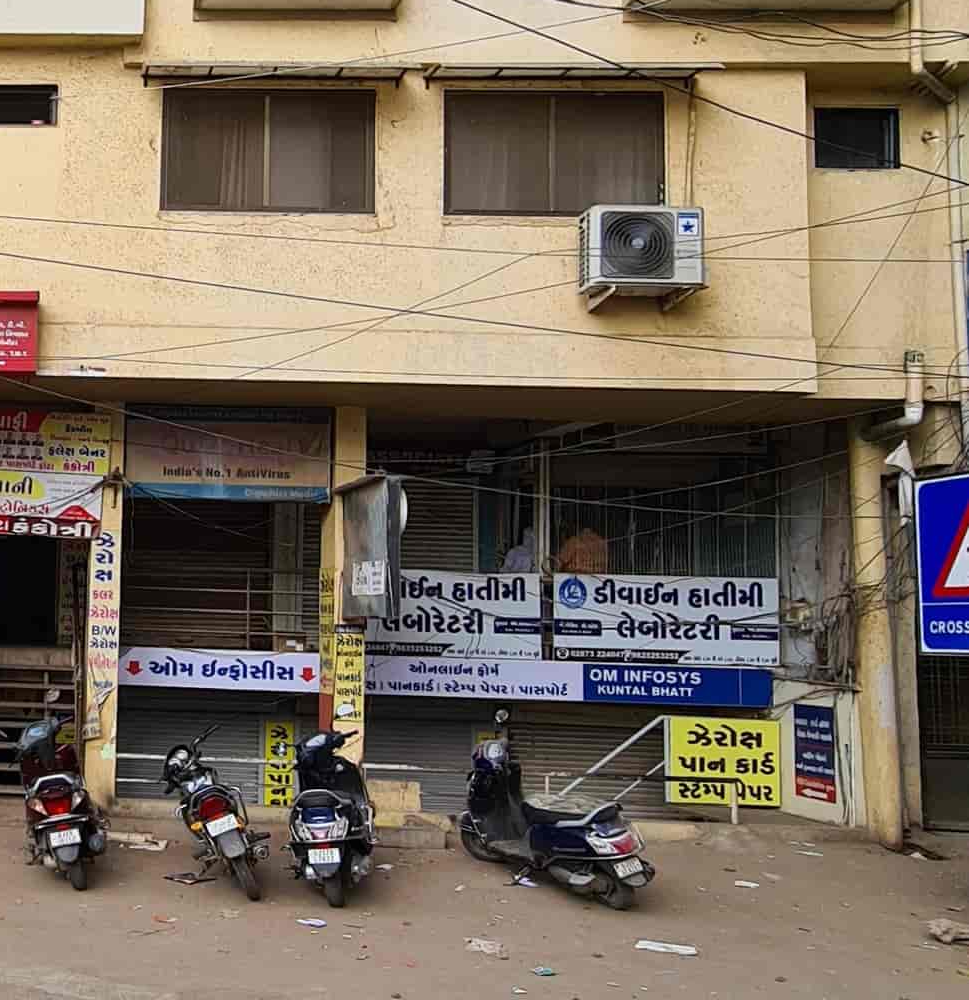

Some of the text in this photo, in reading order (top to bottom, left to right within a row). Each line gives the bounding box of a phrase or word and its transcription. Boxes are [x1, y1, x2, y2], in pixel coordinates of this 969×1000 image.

[163, 465, 202, 478] India's
[206, 466, 231, 478] No.1
[452, 576, 526, 602] હાતીમી
[688, 582, 764, 608] હાતીમી
[91, 625, 116, 636] B/W
[148, 655, 194, 677] ઓમ
[589, 669, 702, 684] OM INFOSYS
[597, 685, 694, 697] KUNTAL BHATT
[687, 723, 764, 750] ઝેરોક્ષ
[679, 751, 775, 775] પાન કાર્ડ
